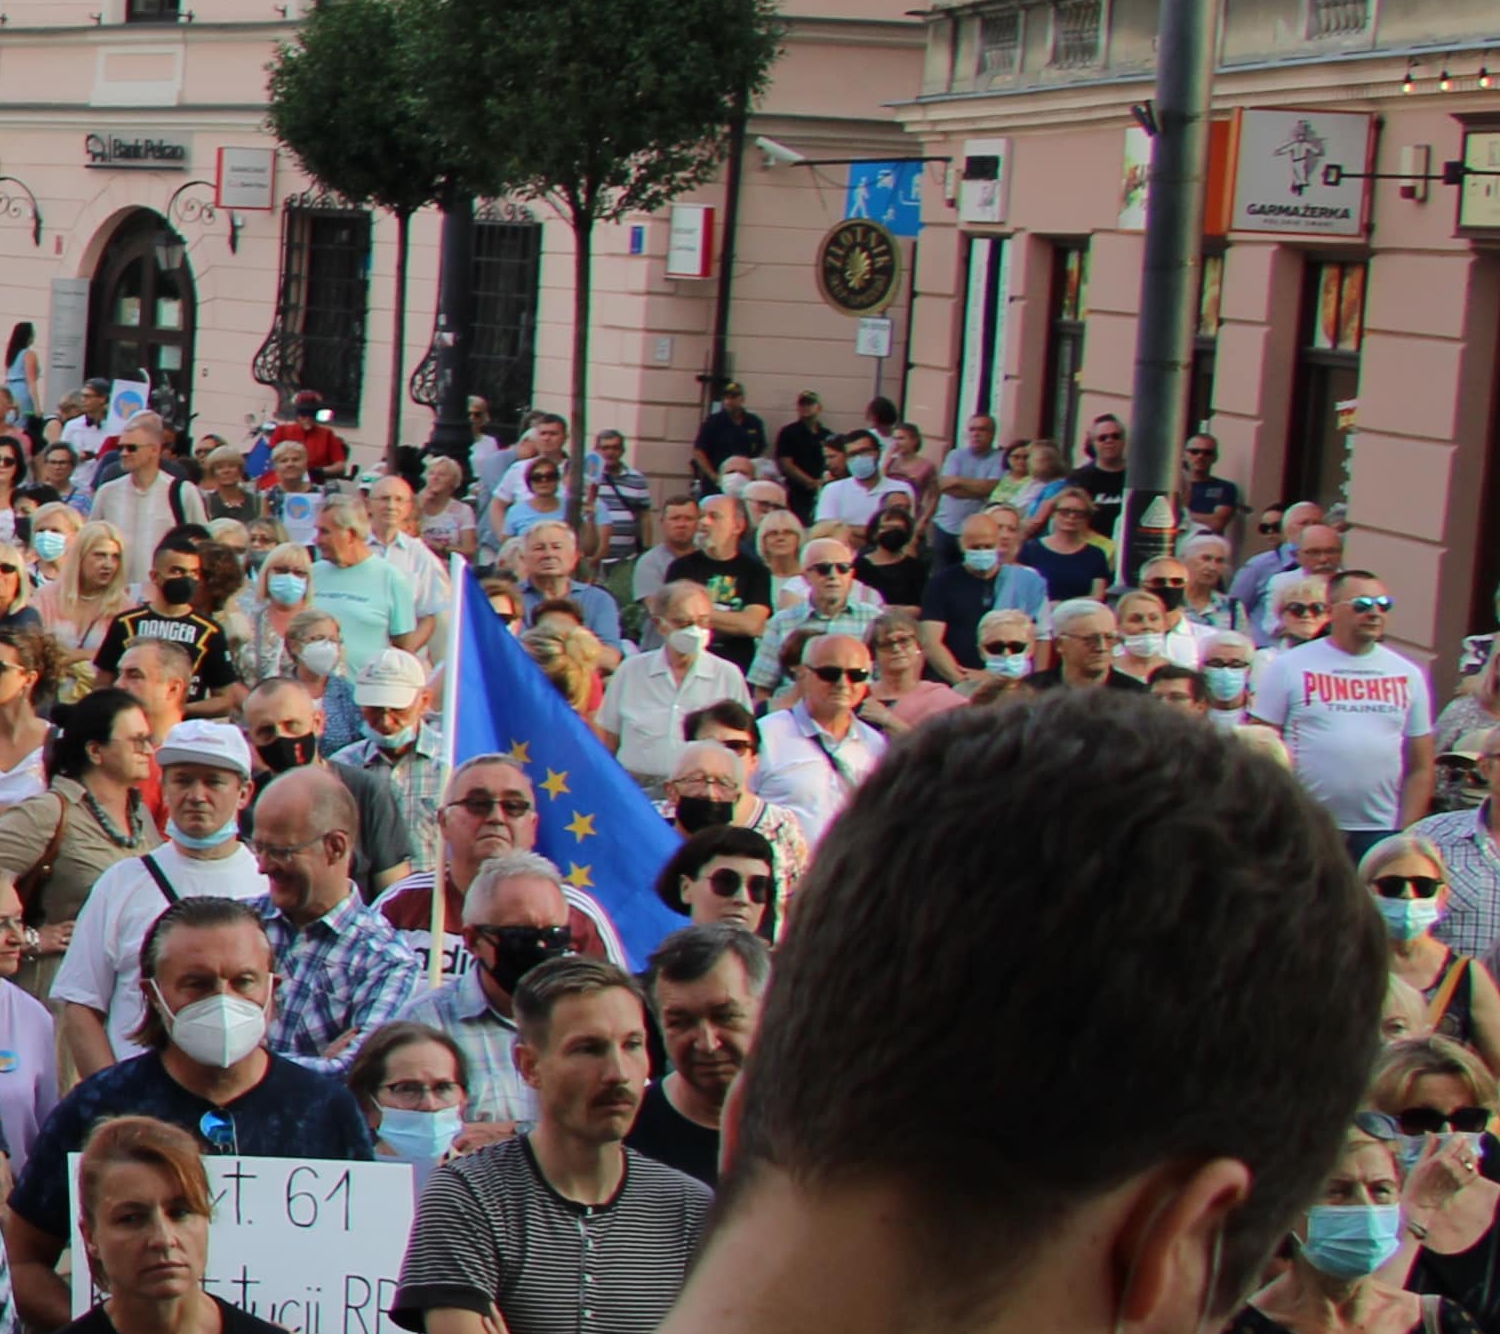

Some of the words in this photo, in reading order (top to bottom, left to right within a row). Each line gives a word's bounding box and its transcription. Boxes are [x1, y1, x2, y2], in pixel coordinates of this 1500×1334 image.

[1247, 202, 1351, 220] GARMAŻERKA
[137, 619, 197, 644] DANGER
[1302, 670, 1408, 709] PUNCHFIT
[286, 1166, 361, 1231] 61
